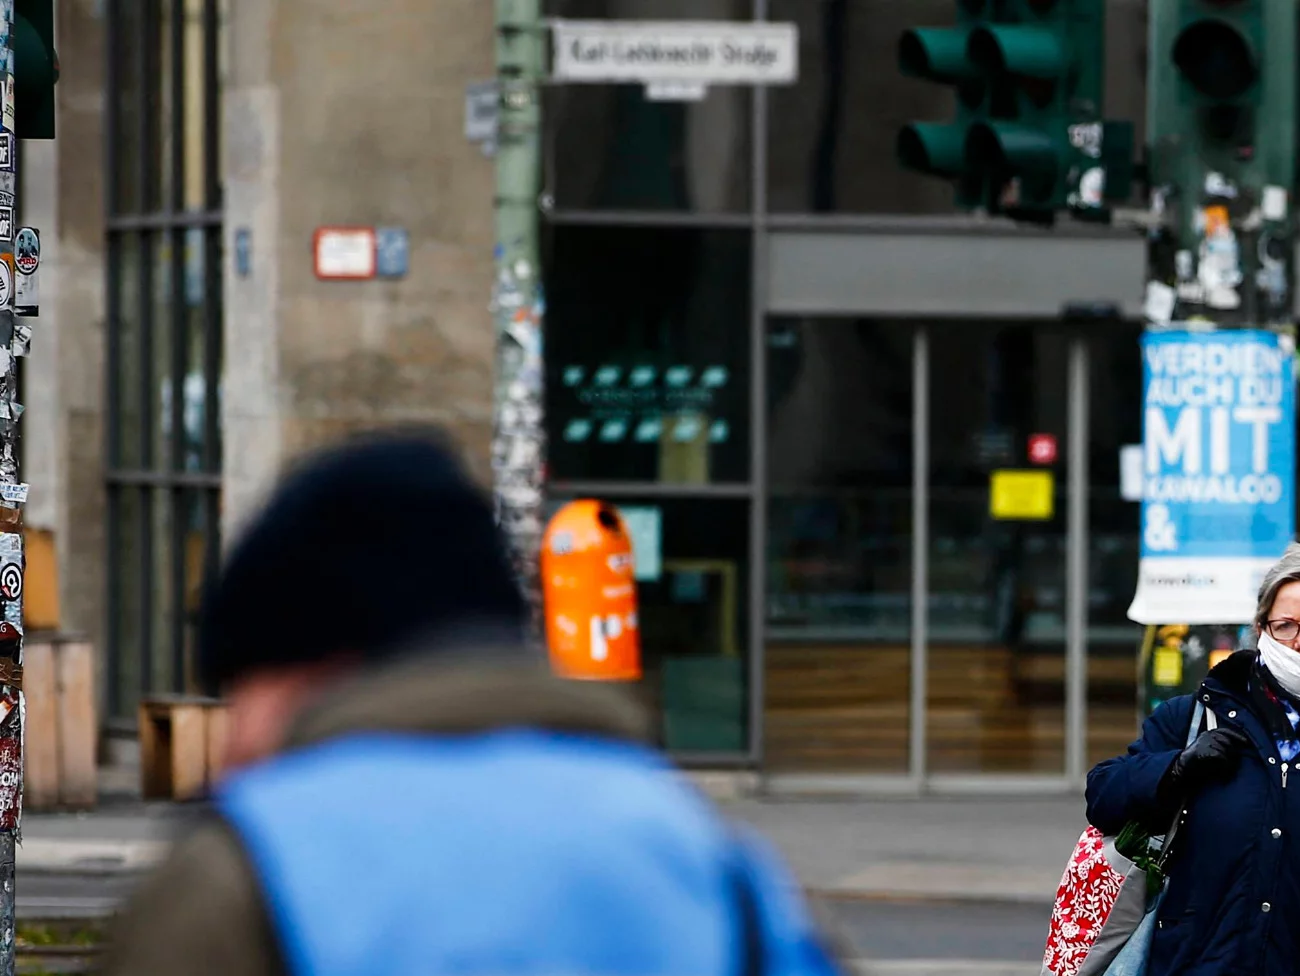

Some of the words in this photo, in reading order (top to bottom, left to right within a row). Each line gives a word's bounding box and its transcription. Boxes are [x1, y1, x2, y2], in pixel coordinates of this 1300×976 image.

[1146, 342, 1283, 376] VERDIEN
[1147, 377, 1233, 407] AUCH
[1239, 376, 1282, 406] DU
[1146, 406, 1283, 474] MIT
[1144, 502, 1177, 550] &
